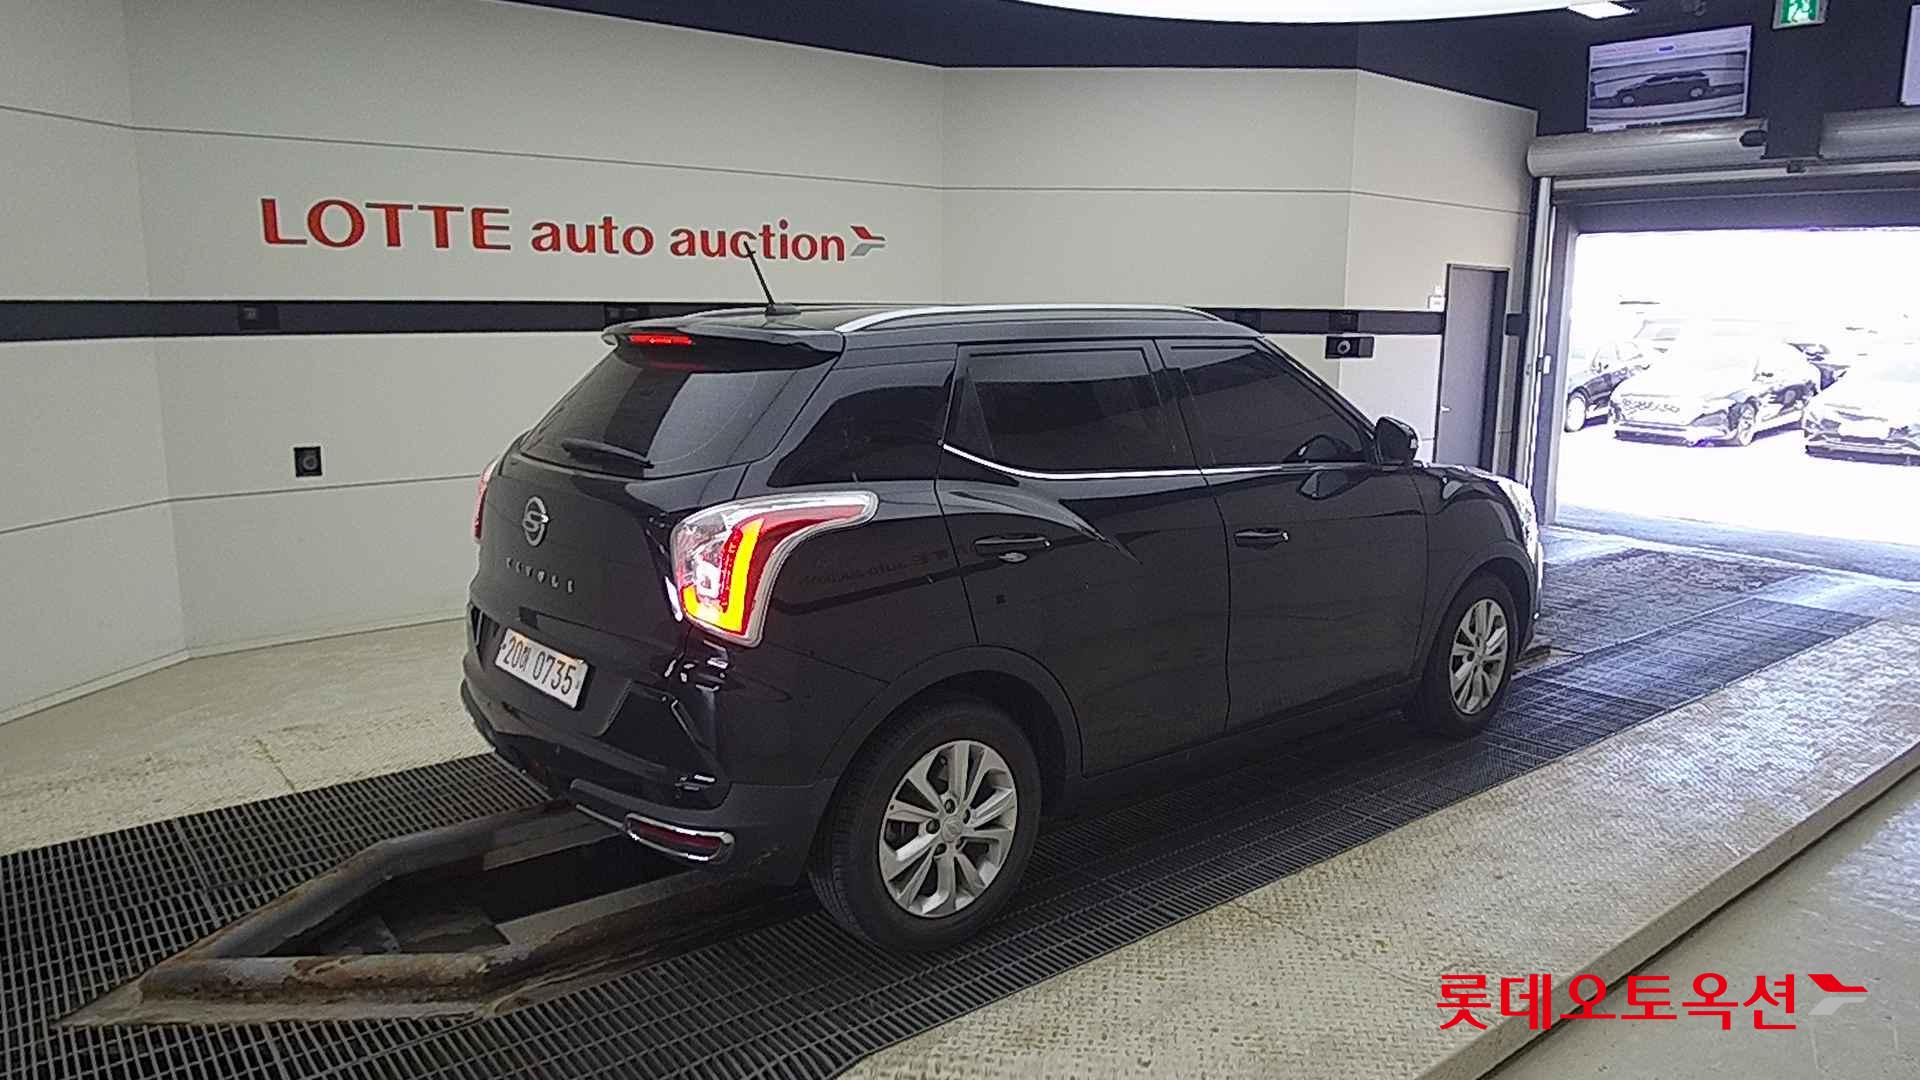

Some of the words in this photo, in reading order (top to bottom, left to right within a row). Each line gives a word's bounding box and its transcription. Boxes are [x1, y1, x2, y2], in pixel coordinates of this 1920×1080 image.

[261, 198, 510, 250] LOTTE
[532, 216, 654, 255] auto
[669, 220, 845, 261] auction
[533, 652, 577, 695] 0735
